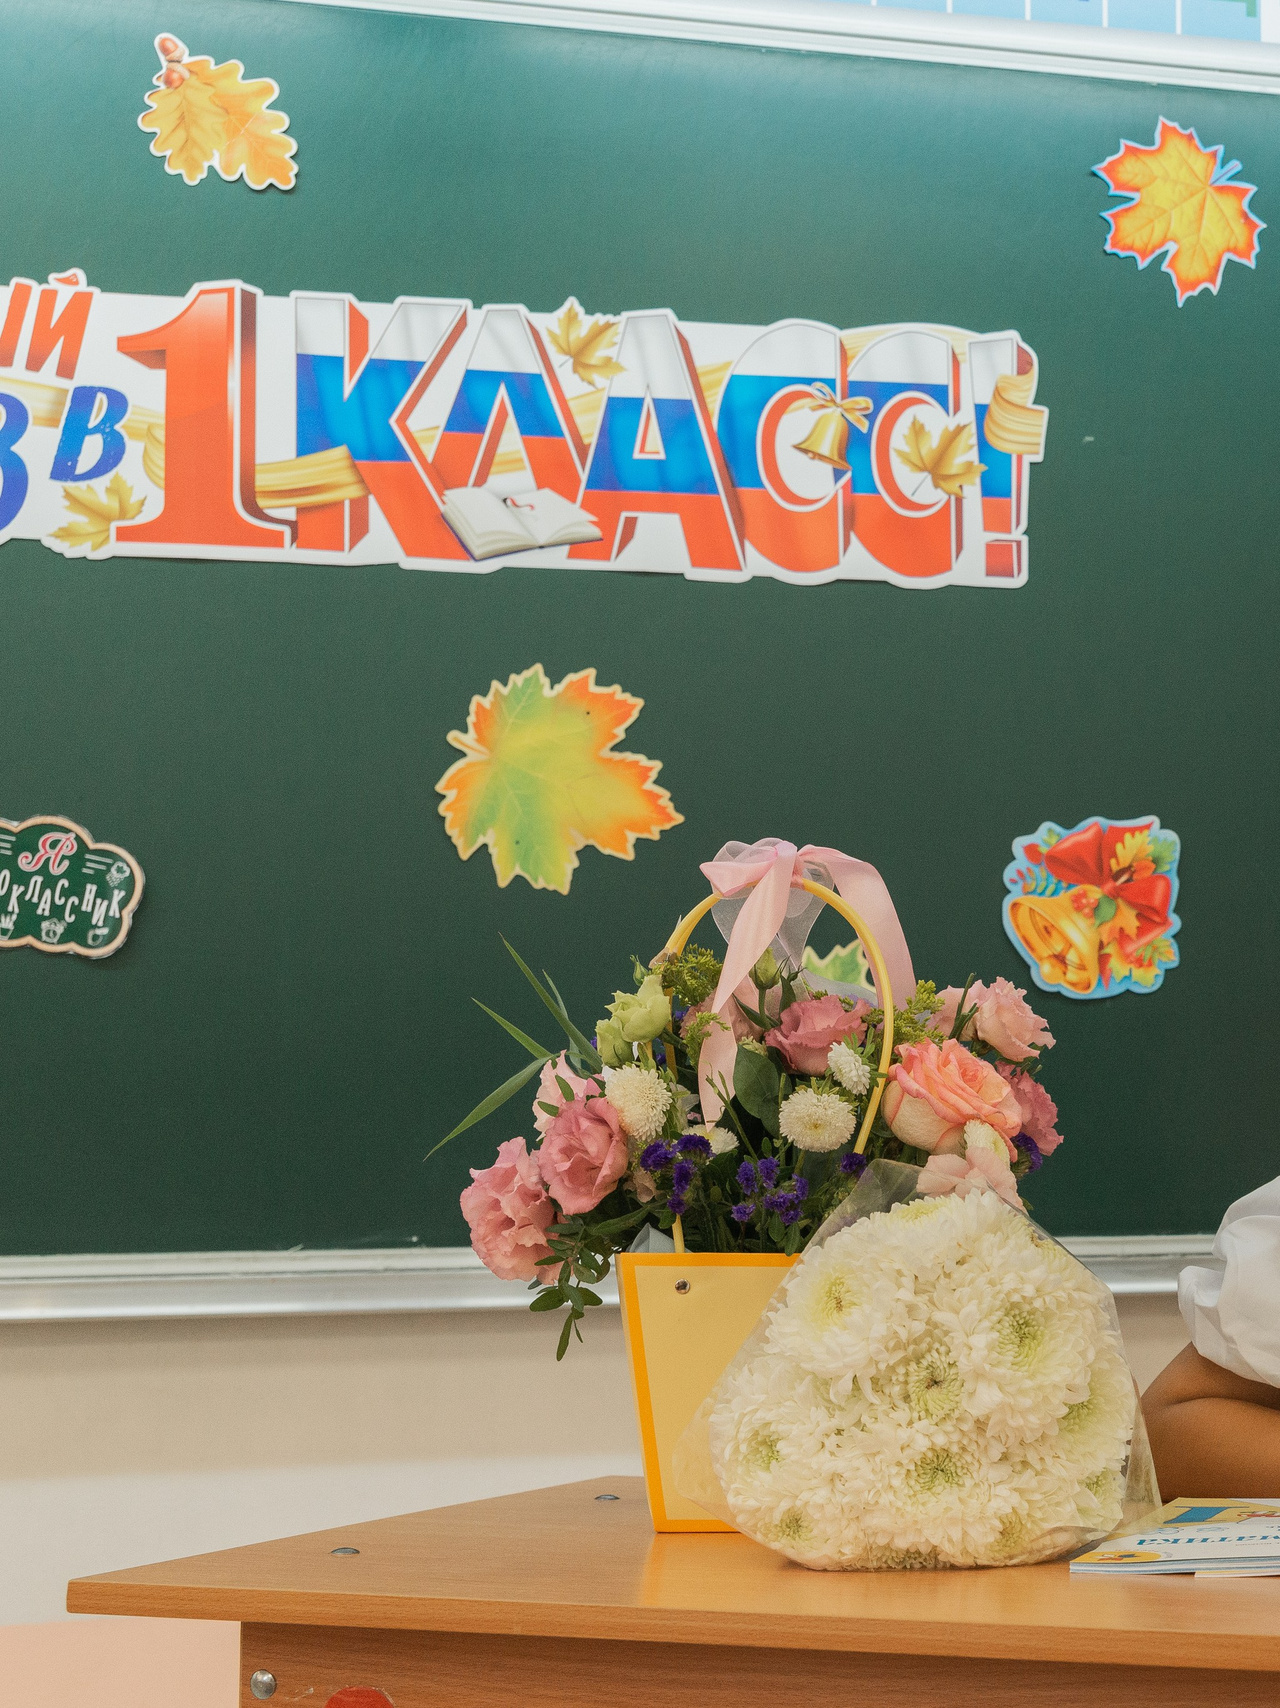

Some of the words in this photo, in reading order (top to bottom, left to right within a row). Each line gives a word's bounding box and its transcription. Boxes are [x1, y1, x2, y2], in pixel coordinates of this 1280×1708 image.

[115, 285, 299, 550] 1
[294, 295, 1033, 580] КЛАСС!
[17, 831, 78, 876] Я
